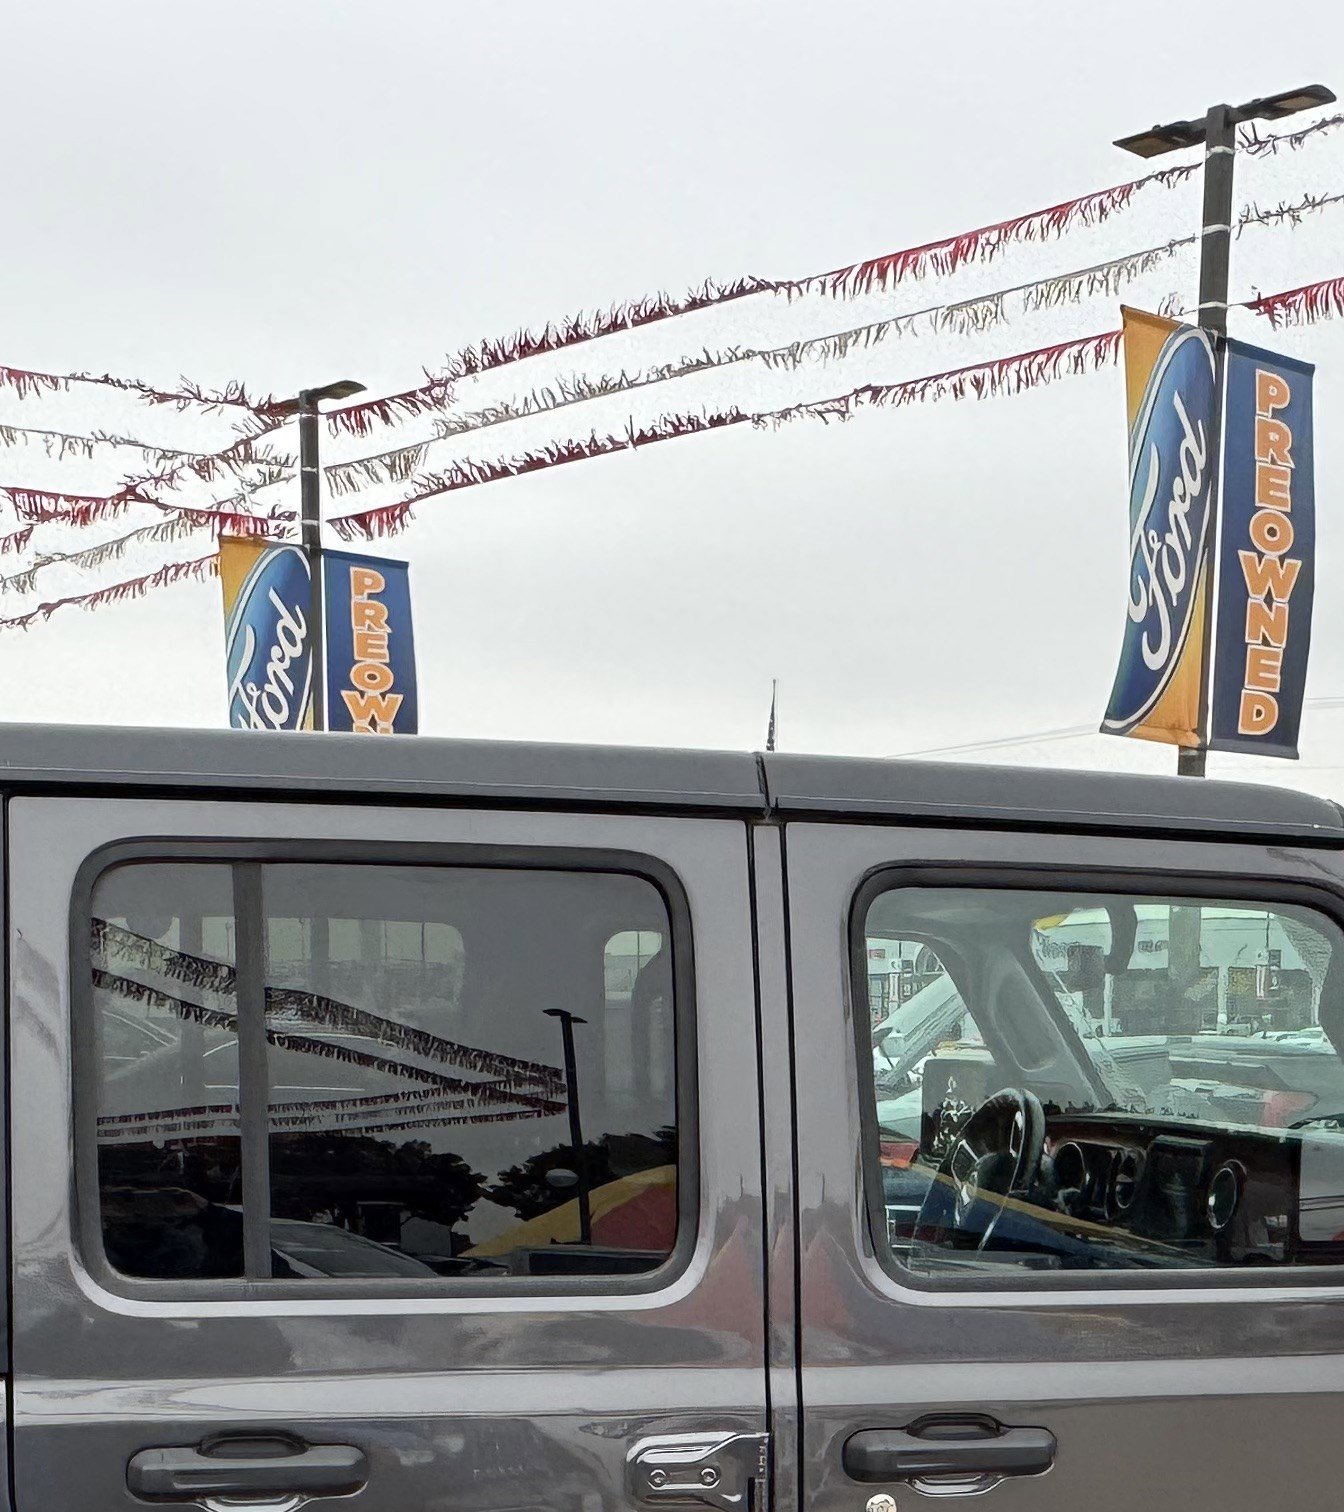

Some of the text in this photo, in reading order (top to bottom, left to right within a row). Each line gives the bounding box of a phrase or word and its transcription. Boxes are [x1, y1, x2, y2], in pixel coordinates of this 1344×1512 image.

[340, 565, 404, 736] PREOW
[1128, 389, 1206, 671] Ford
[1237, 367, 1303, 737] PREOWNED
